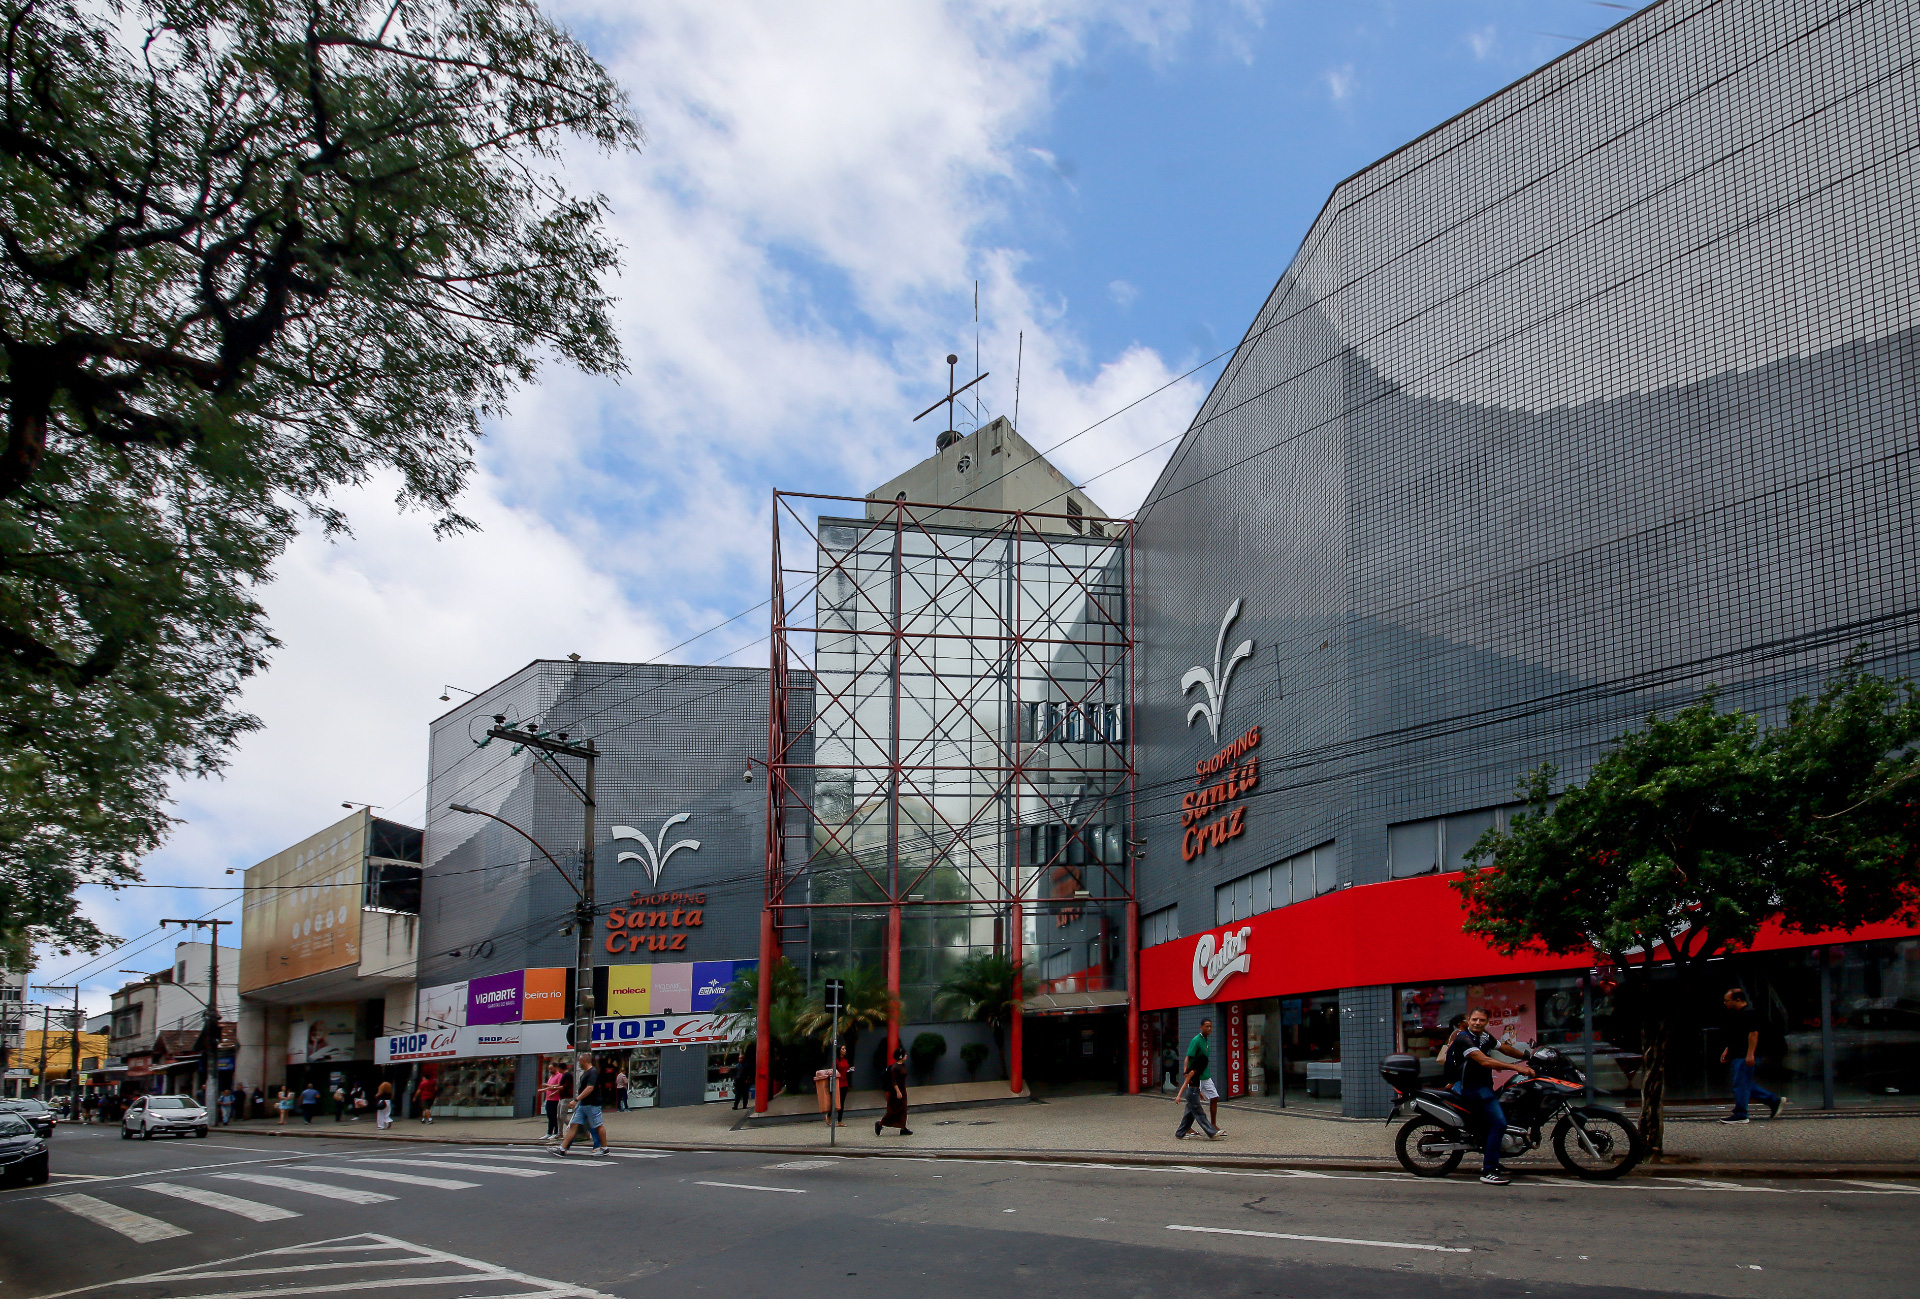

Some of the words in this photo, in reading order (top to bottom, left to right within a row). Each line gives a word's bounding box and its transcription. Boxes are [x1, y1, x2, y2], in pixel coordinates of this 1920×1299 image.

[1195, 726, 1260, 785] SHOPPING
[1180, 756, 1258, 827] Santa
[1181, 805, 1246, 861] Cruz
[629, 890, 706, 906] SHOPPING
[605, 906, 704, 929] Santa
[605, 930, 688, 953] Cruz
[1192, 926, 1251, 1000] Castor
[524, 991, 548, 1000] beira
[550, 990, 562, 999] rio
[612, 987, 646, 995] moleca
[390, 1034, 427, 1054] SHOP
[430, 1029, 457, 1050] Cal
[566, 1019, 666, 1047] HOP
[1231, 1005, 1240, 1094] COLCHÕES
